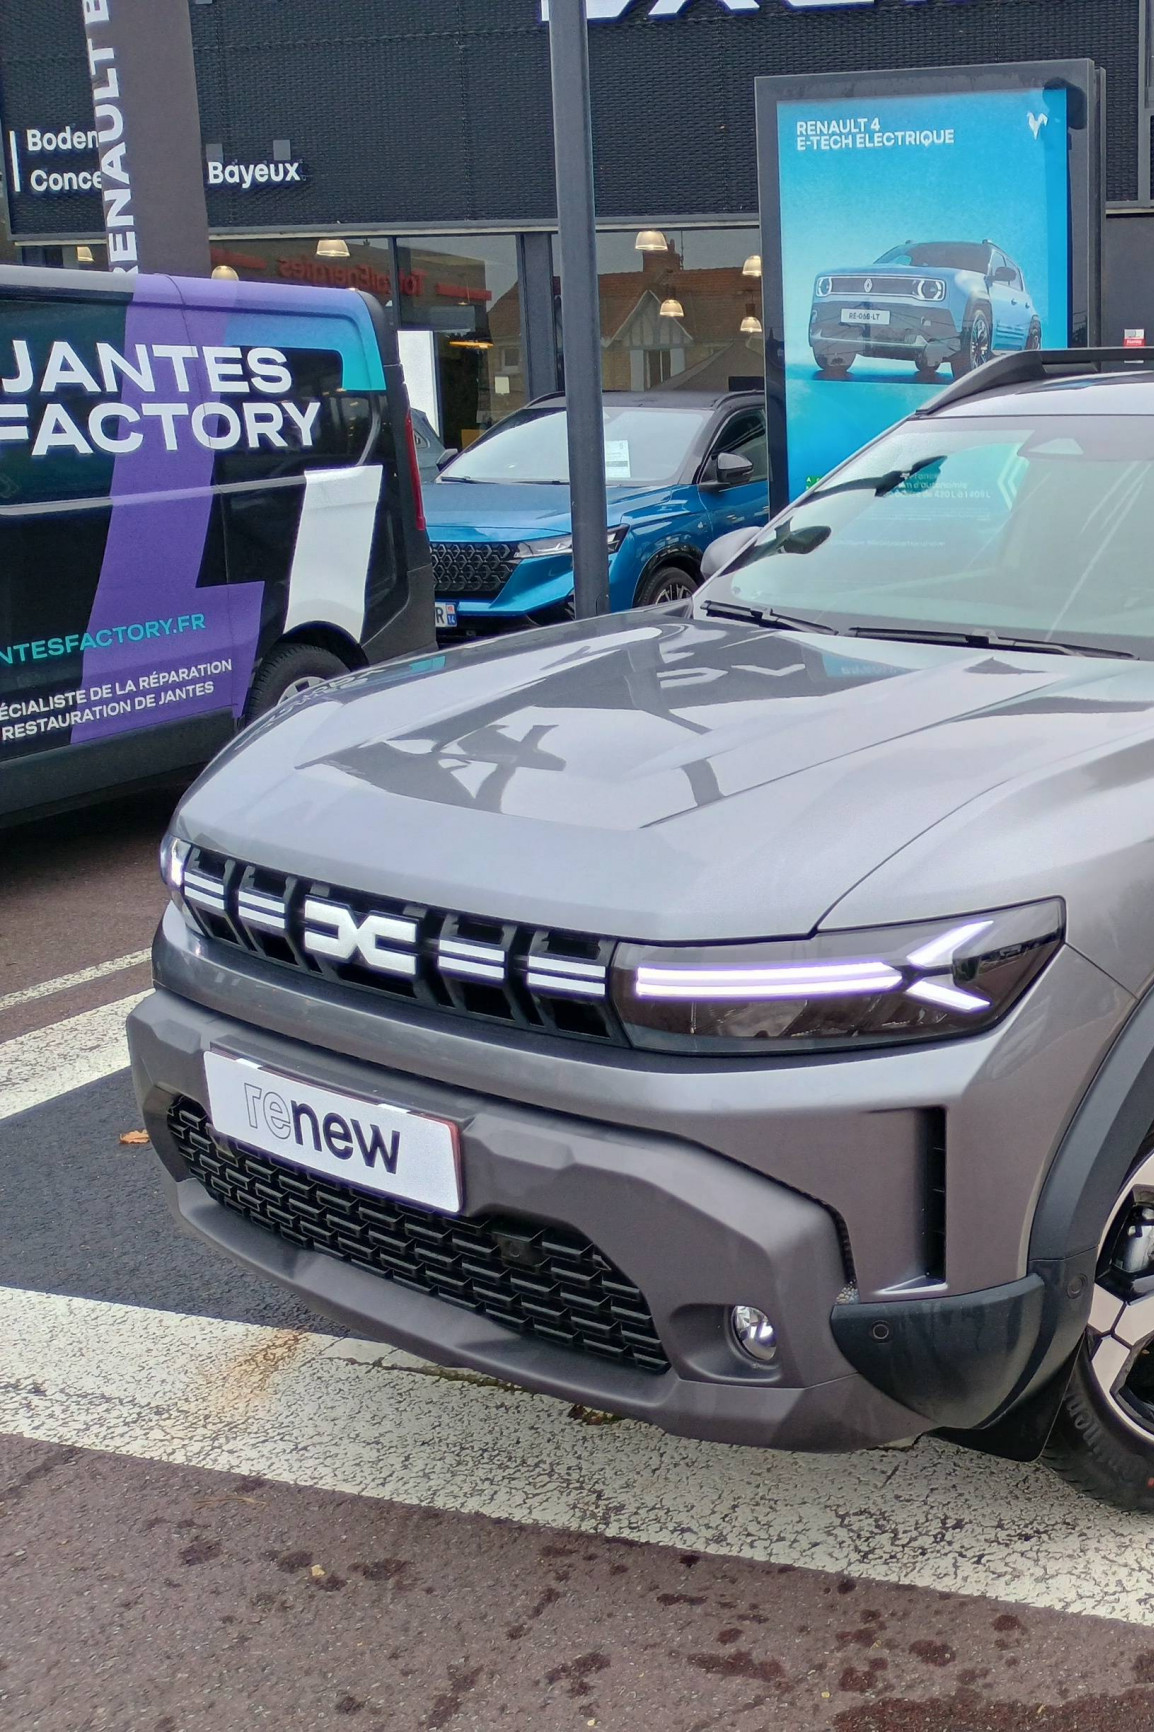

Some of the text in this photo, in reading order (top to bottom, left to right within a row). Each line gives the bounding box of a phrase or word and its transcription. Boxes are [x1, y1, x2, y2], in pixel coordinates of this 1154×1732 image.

[796, 117, 880, 135] RENAULT 4
[797, 129, 955, 150] E-TECH ELECTRIQUE
[207, 161, 301, 188] Bayeux
[1, 339, 292, 394] JANTES
[90, 684, 112, 701] DE
[115, 679, 137, 695] LA
[138, 658, 232, 690] RÉPARATION
[2, 681, 215, 740] RESTAURATION DE JANTES
[244, 1082, 401, 1175] renew
